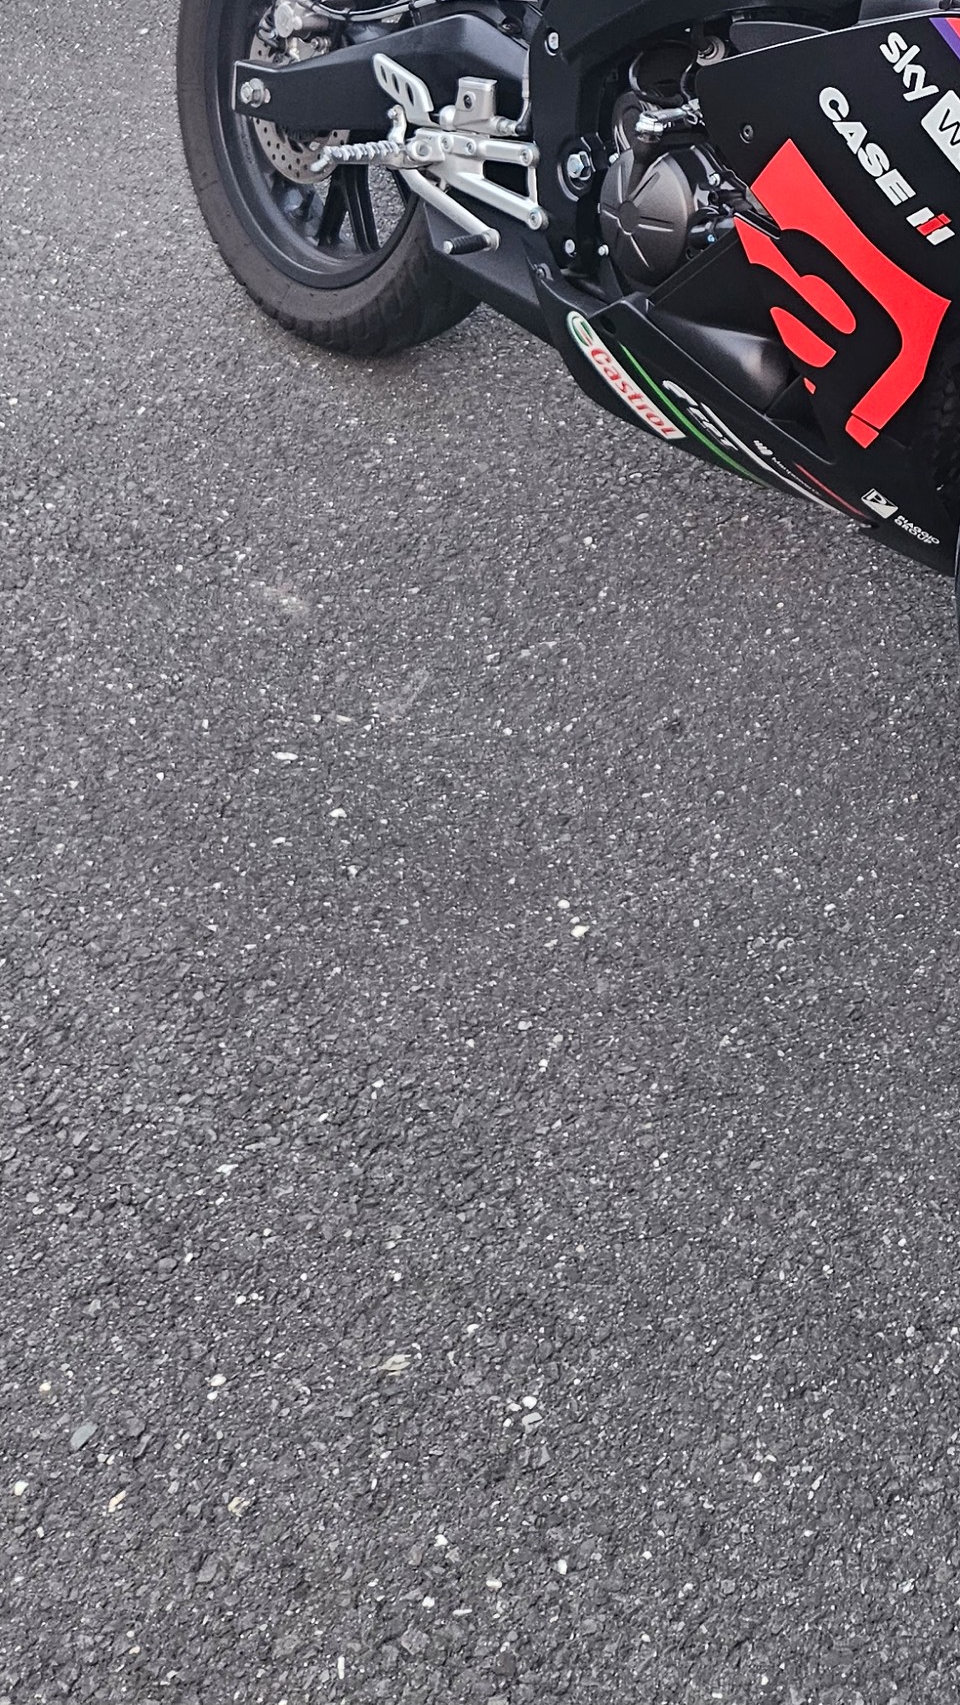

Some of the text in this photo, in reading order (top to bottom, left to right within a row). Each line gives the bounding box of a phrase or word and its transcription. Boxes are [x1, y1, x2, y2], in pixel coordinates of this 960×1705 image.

[879, 31, 940, 102] sky
[819, 86, 917, 206] CASE
[590, 345, 676, 437] Castrol
